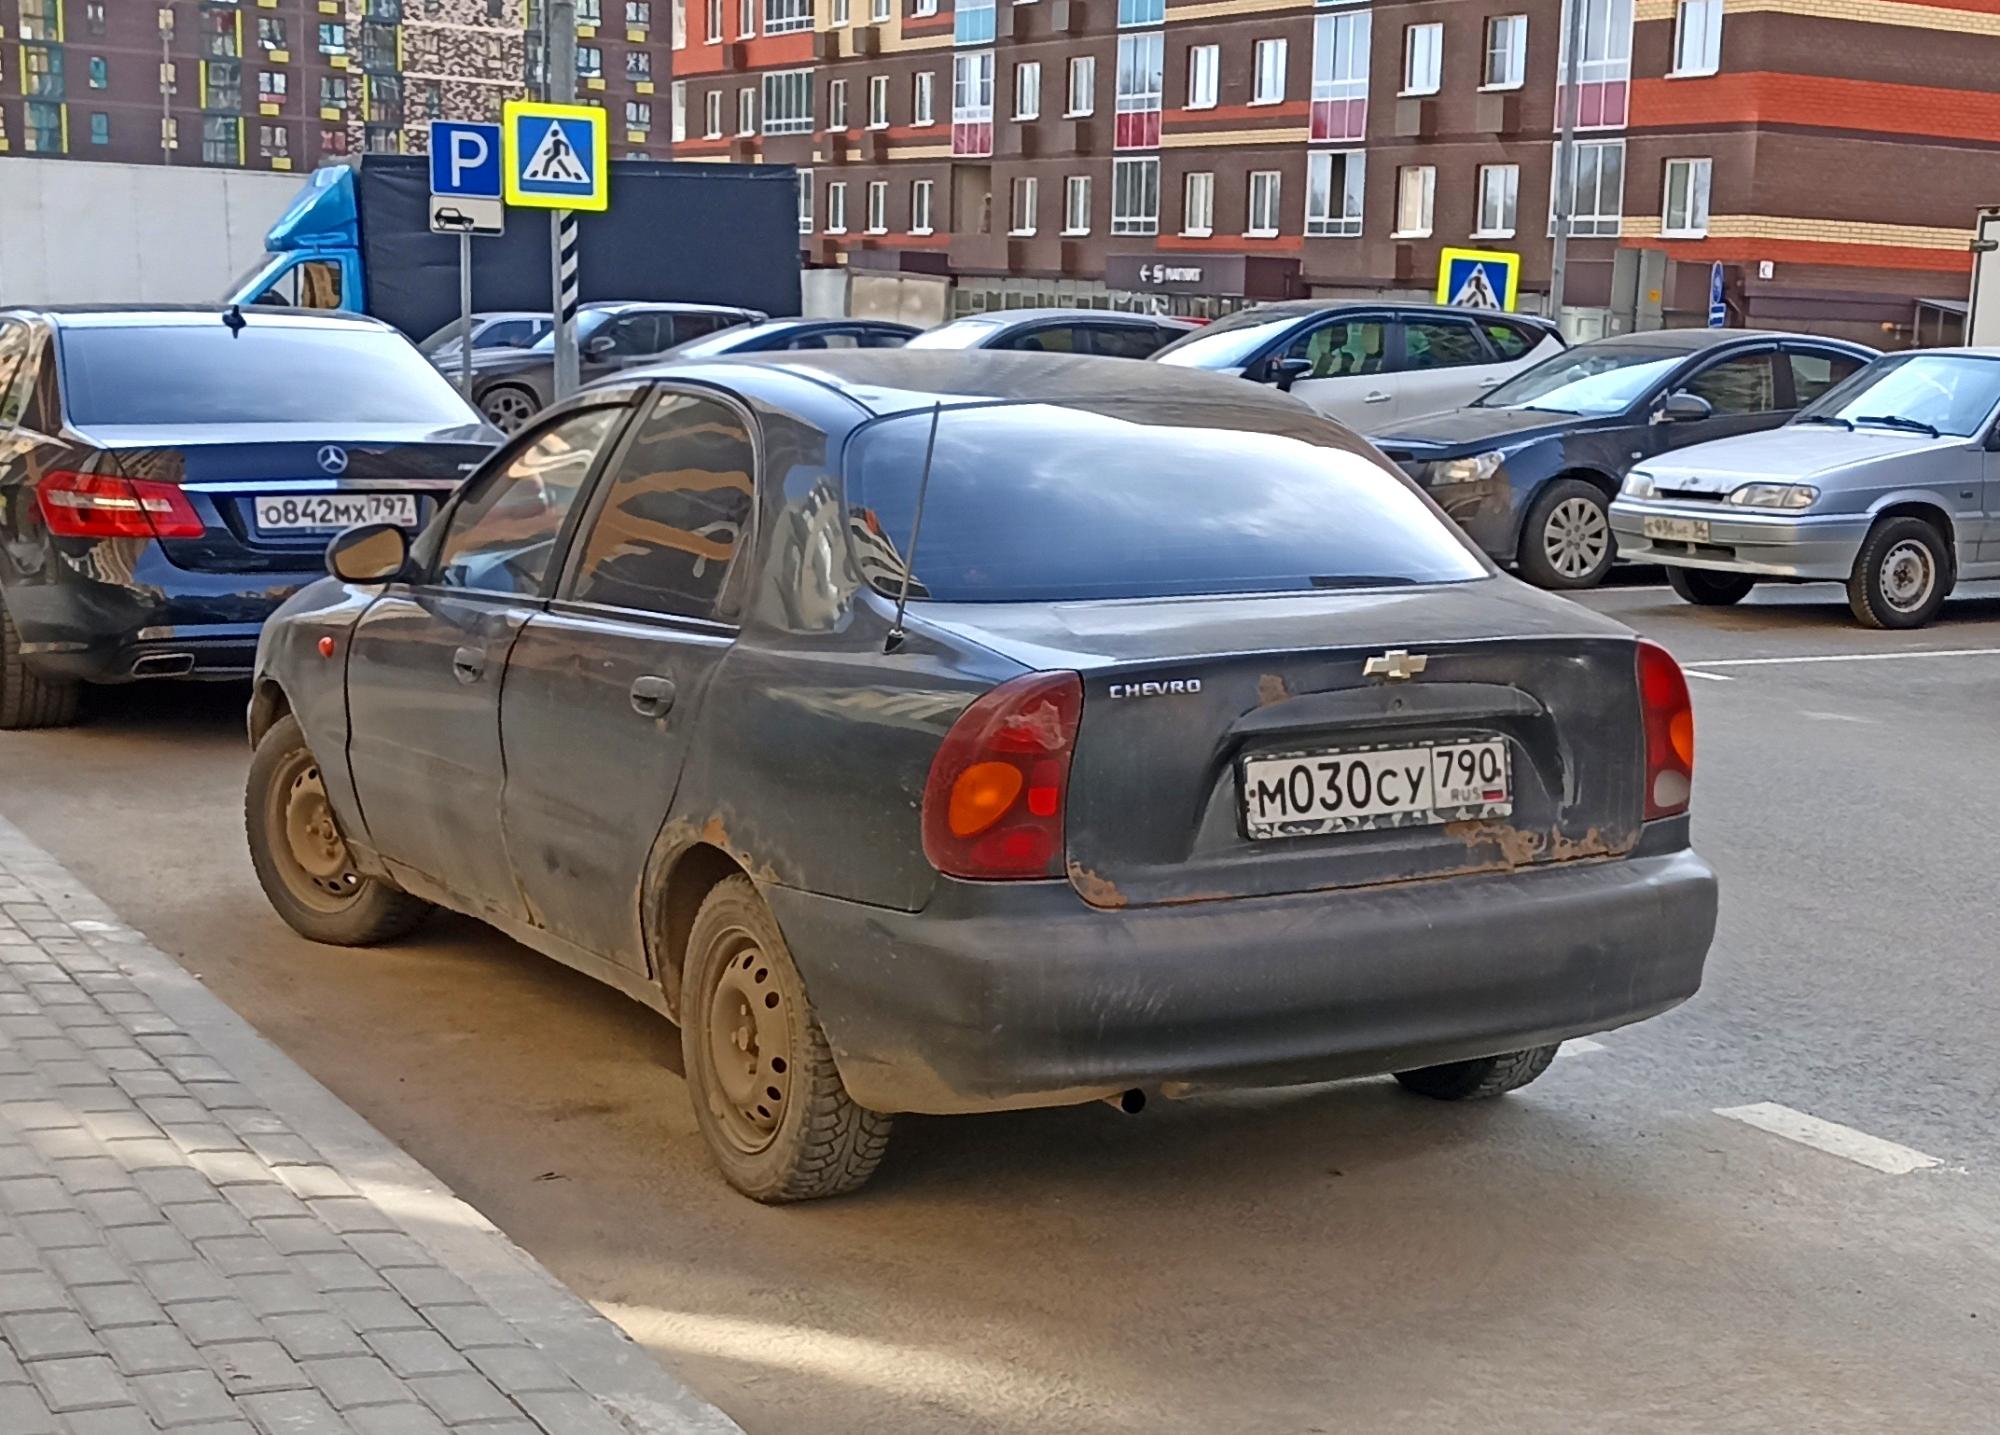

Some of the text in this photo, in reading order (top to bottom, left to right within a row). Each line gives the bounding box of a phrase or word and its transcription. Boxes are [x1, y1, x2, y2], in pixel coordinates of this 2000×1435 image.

[450, 130, 489, 188] P
[264, 497, 407, 525] О842МХ 797
[1109, 679, 1201, 699] CHEVRO
[1257, 747, 1498, 818] М030СУ 790
[1450, 787, 1481, 801] RUS
